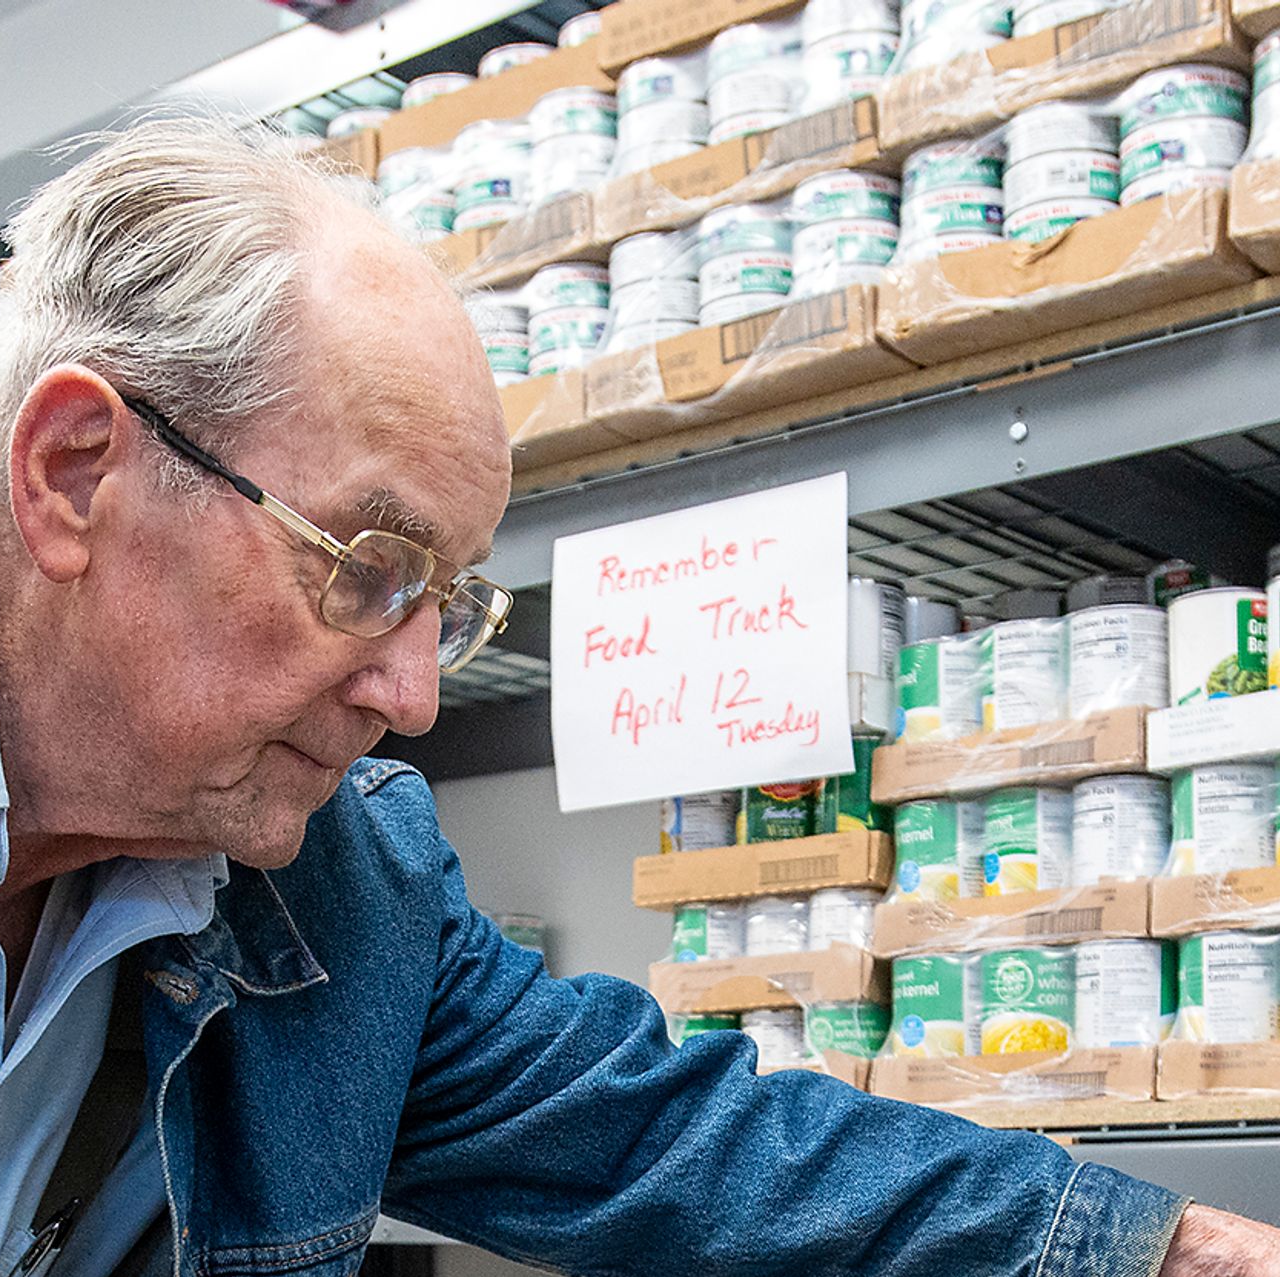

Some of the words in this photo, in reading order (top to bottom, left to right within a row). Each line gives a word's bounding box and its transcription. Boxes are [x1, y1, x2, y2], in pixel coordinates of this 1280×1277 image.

[598, 536, 778, 596] Remember
[584, 615, 657, 667] Food
[699, 584, 808, 639] Truck
[612, 674, 686, 745] April
[711, 668, 763, 714] 12
[717, 702, 820, 748] Tuesday
